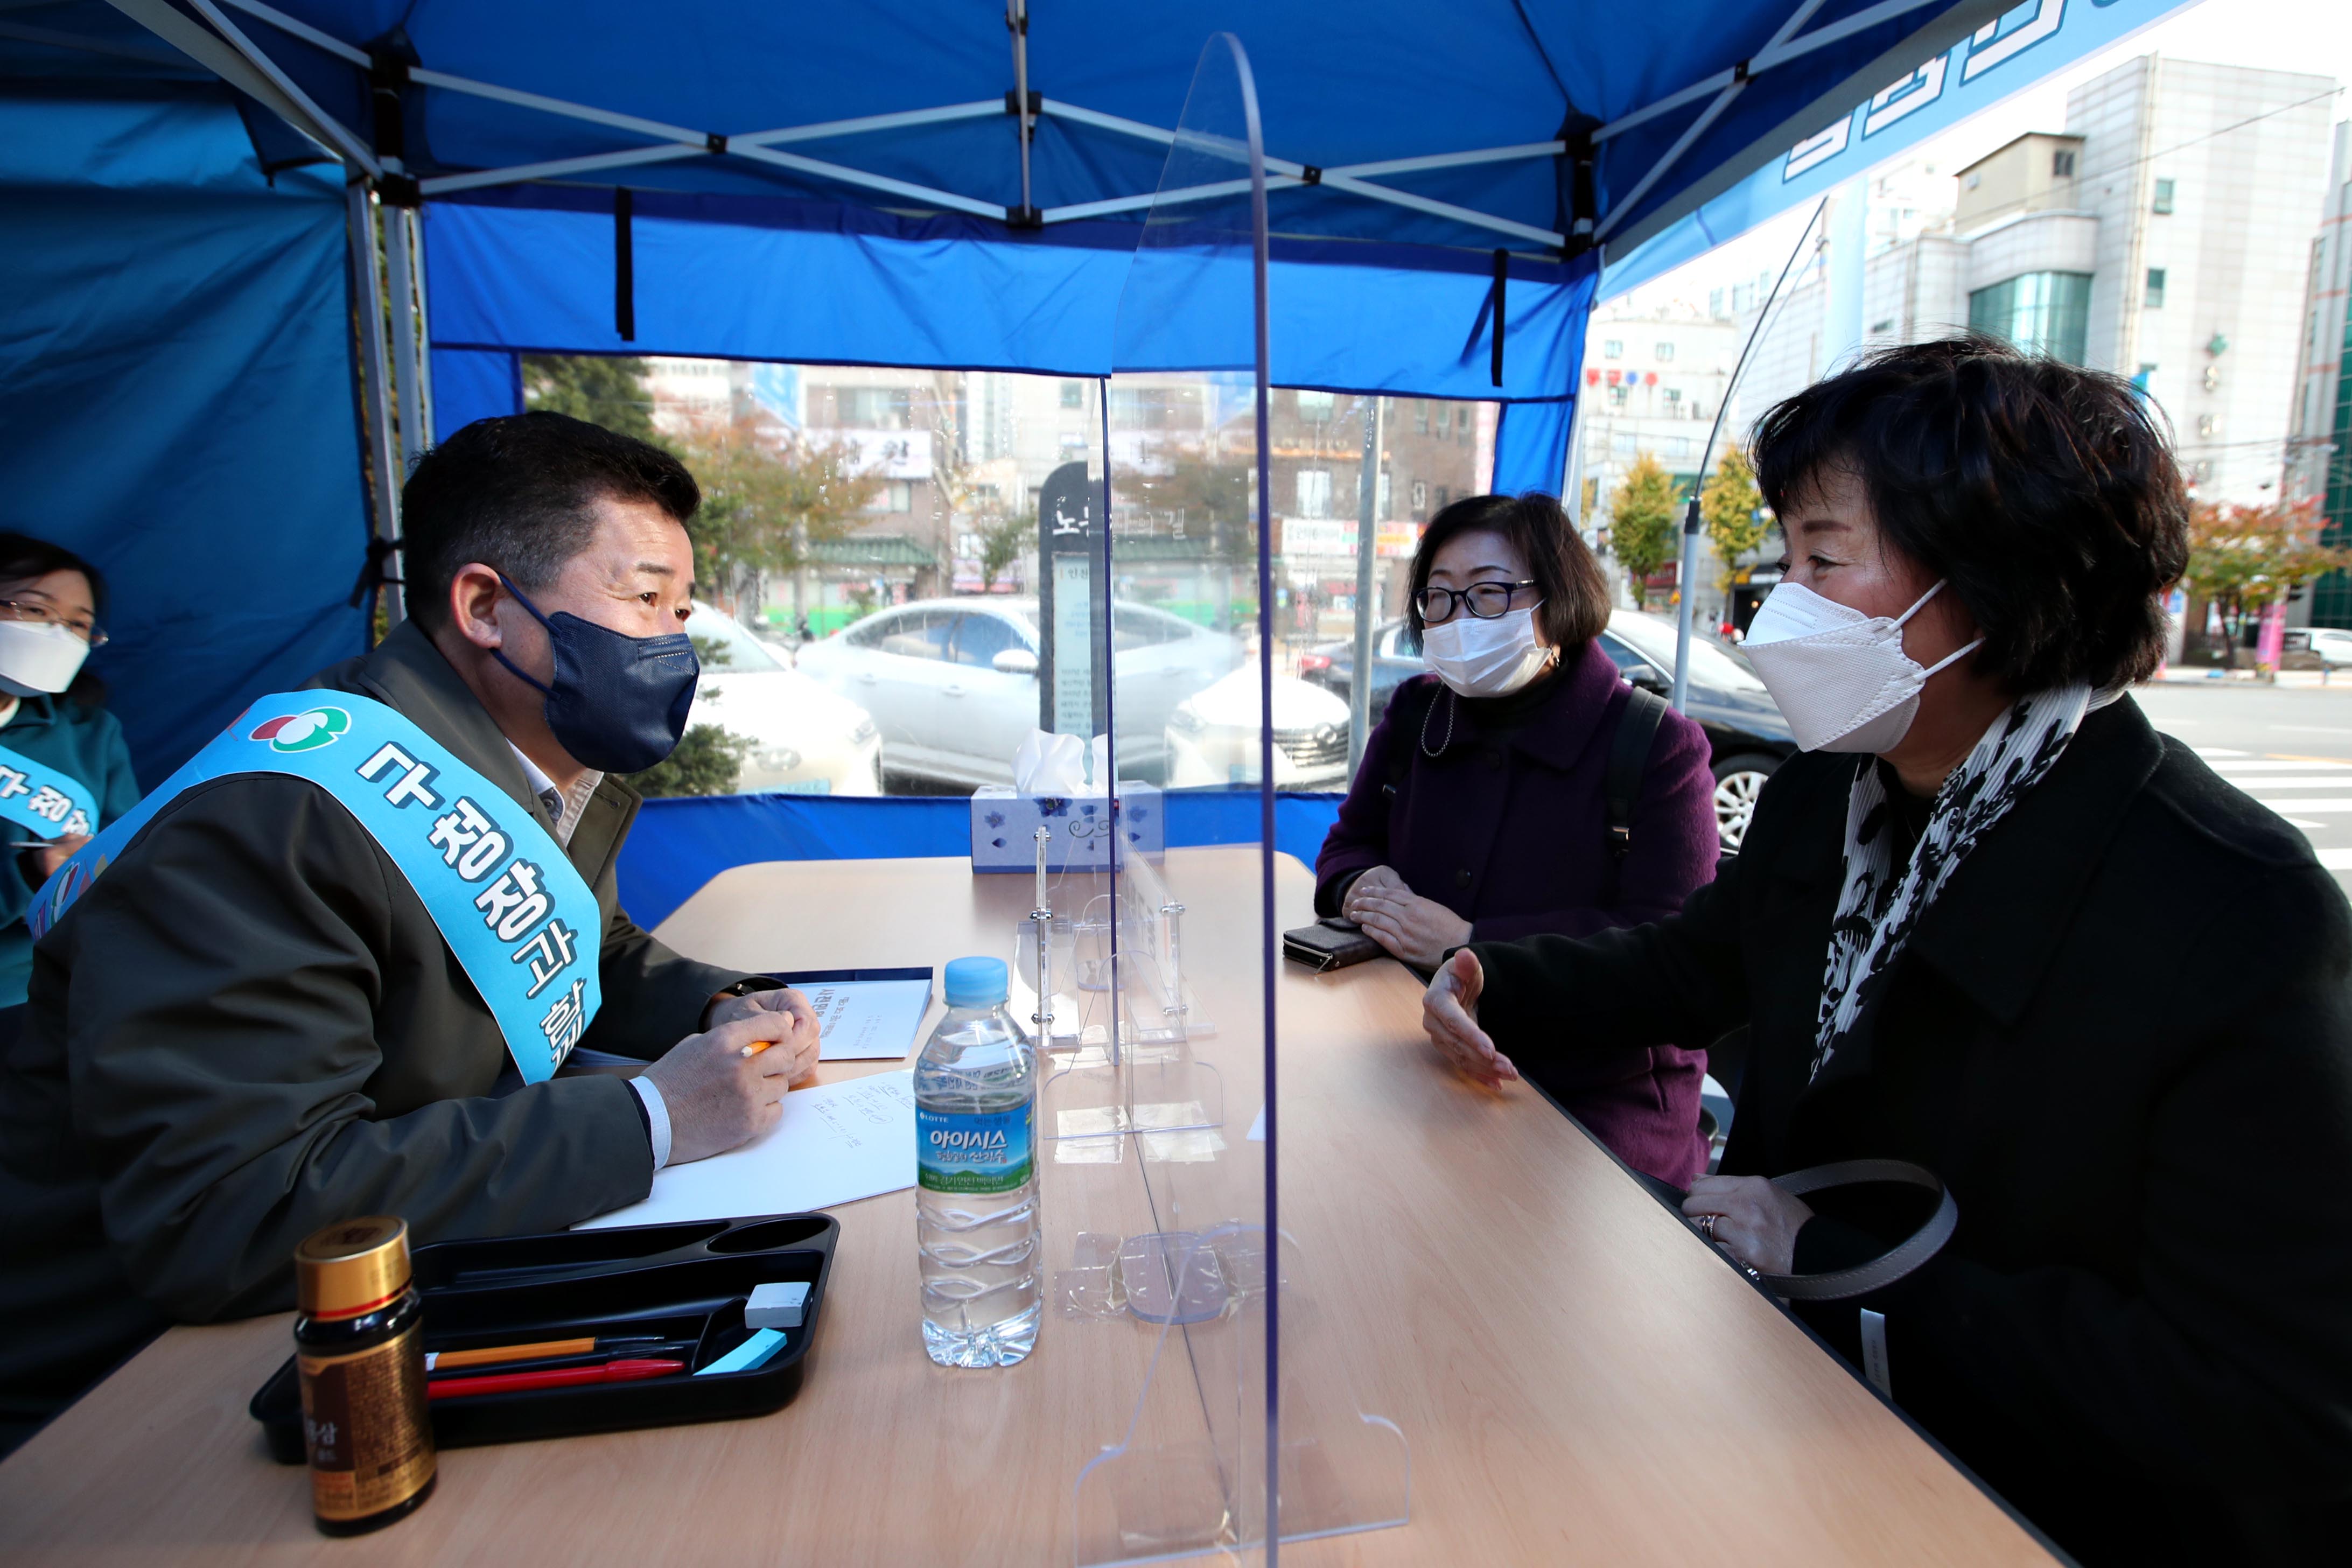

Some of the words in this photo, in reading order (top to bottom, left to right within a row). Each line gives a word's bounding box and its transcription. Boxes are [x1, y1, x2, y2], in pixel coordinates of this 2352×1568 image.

[355, 740, 579, 999] 구청장과
[925, 1115, 949, 1123] LOTTE
[930, 1129, 1008, 1150] 아이시스
